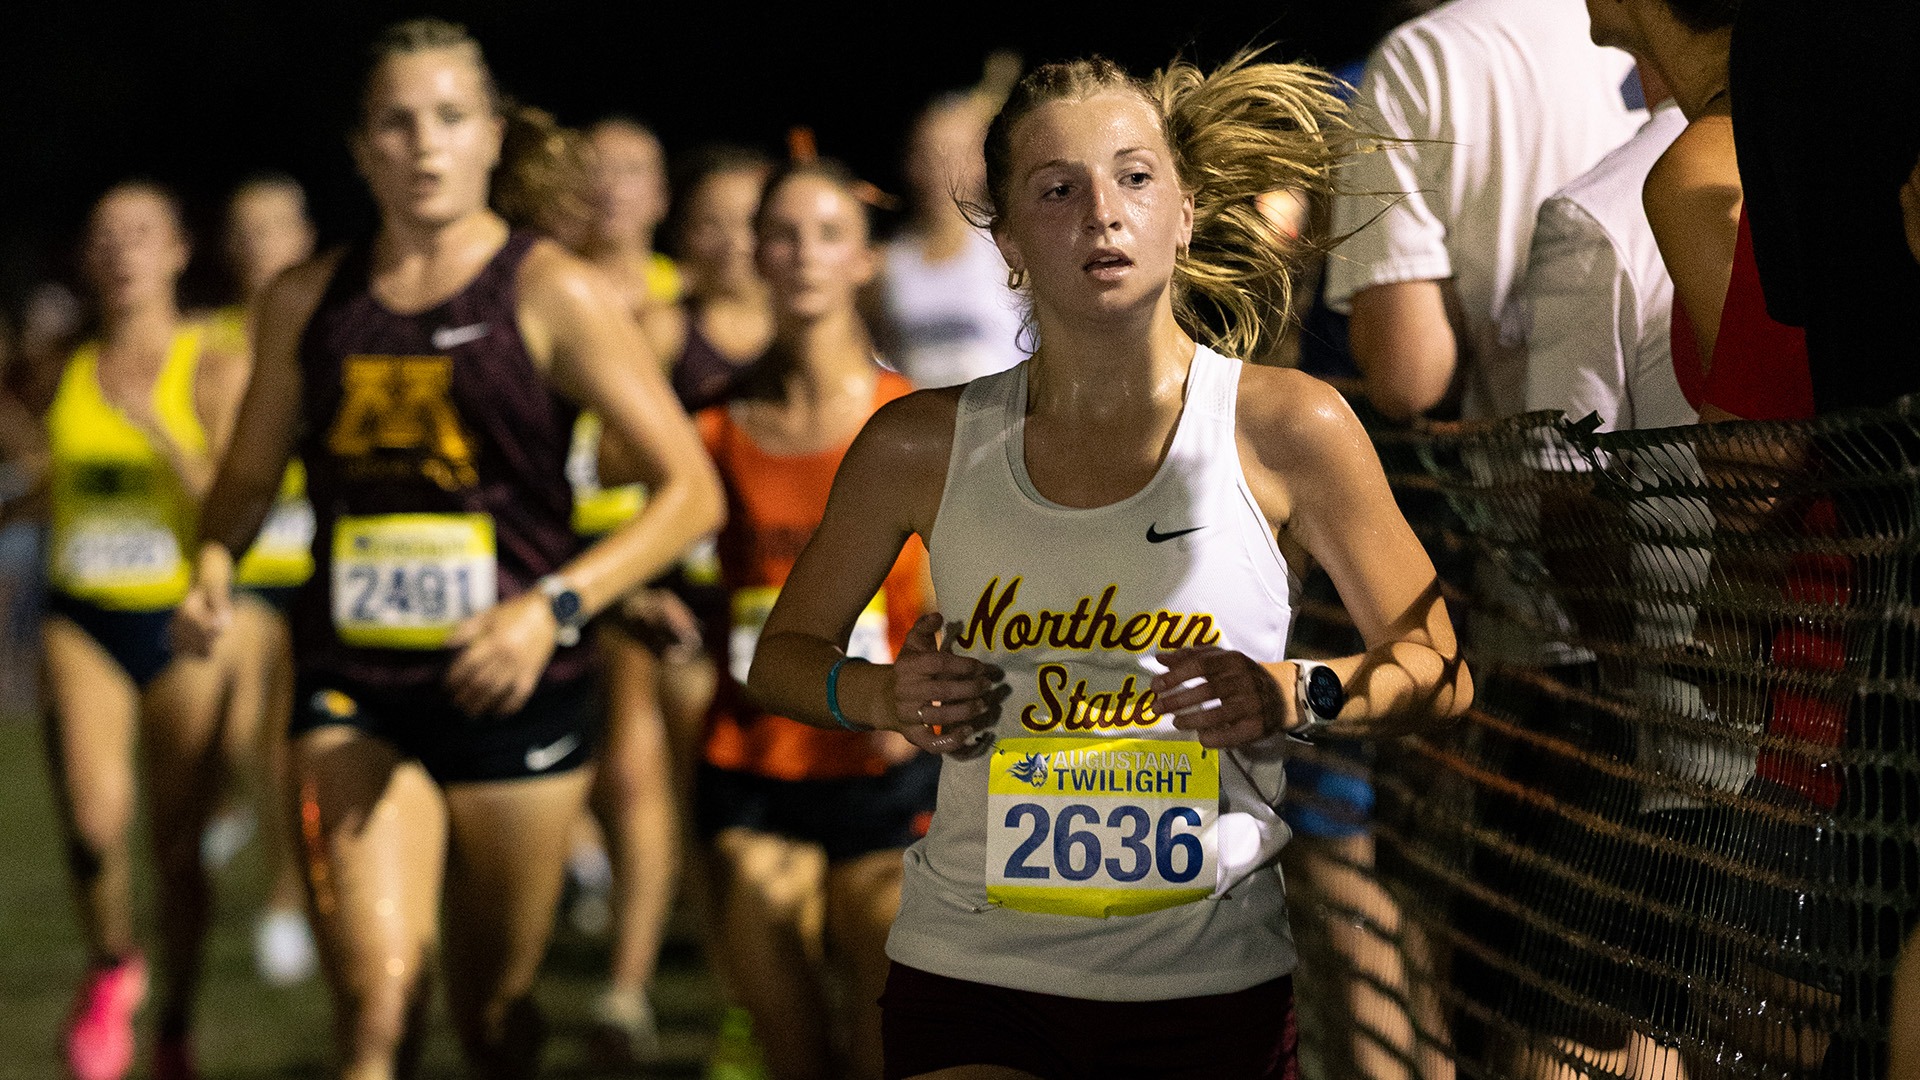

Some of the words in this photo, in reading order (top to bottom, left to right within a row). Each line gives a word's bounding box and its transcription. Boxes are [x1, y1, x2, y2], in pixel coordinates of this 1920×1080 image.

[350, 566, 475, 621] 2491
[958, 576, 1222, 652] Northern
[1021, 663, 1162, 732] State
[1053, 750, 1192, 771] AUGUSTANA
[1053, 769, 1192, 794] TWILIGHT
[1003, 803, 1204, 882] 2636
